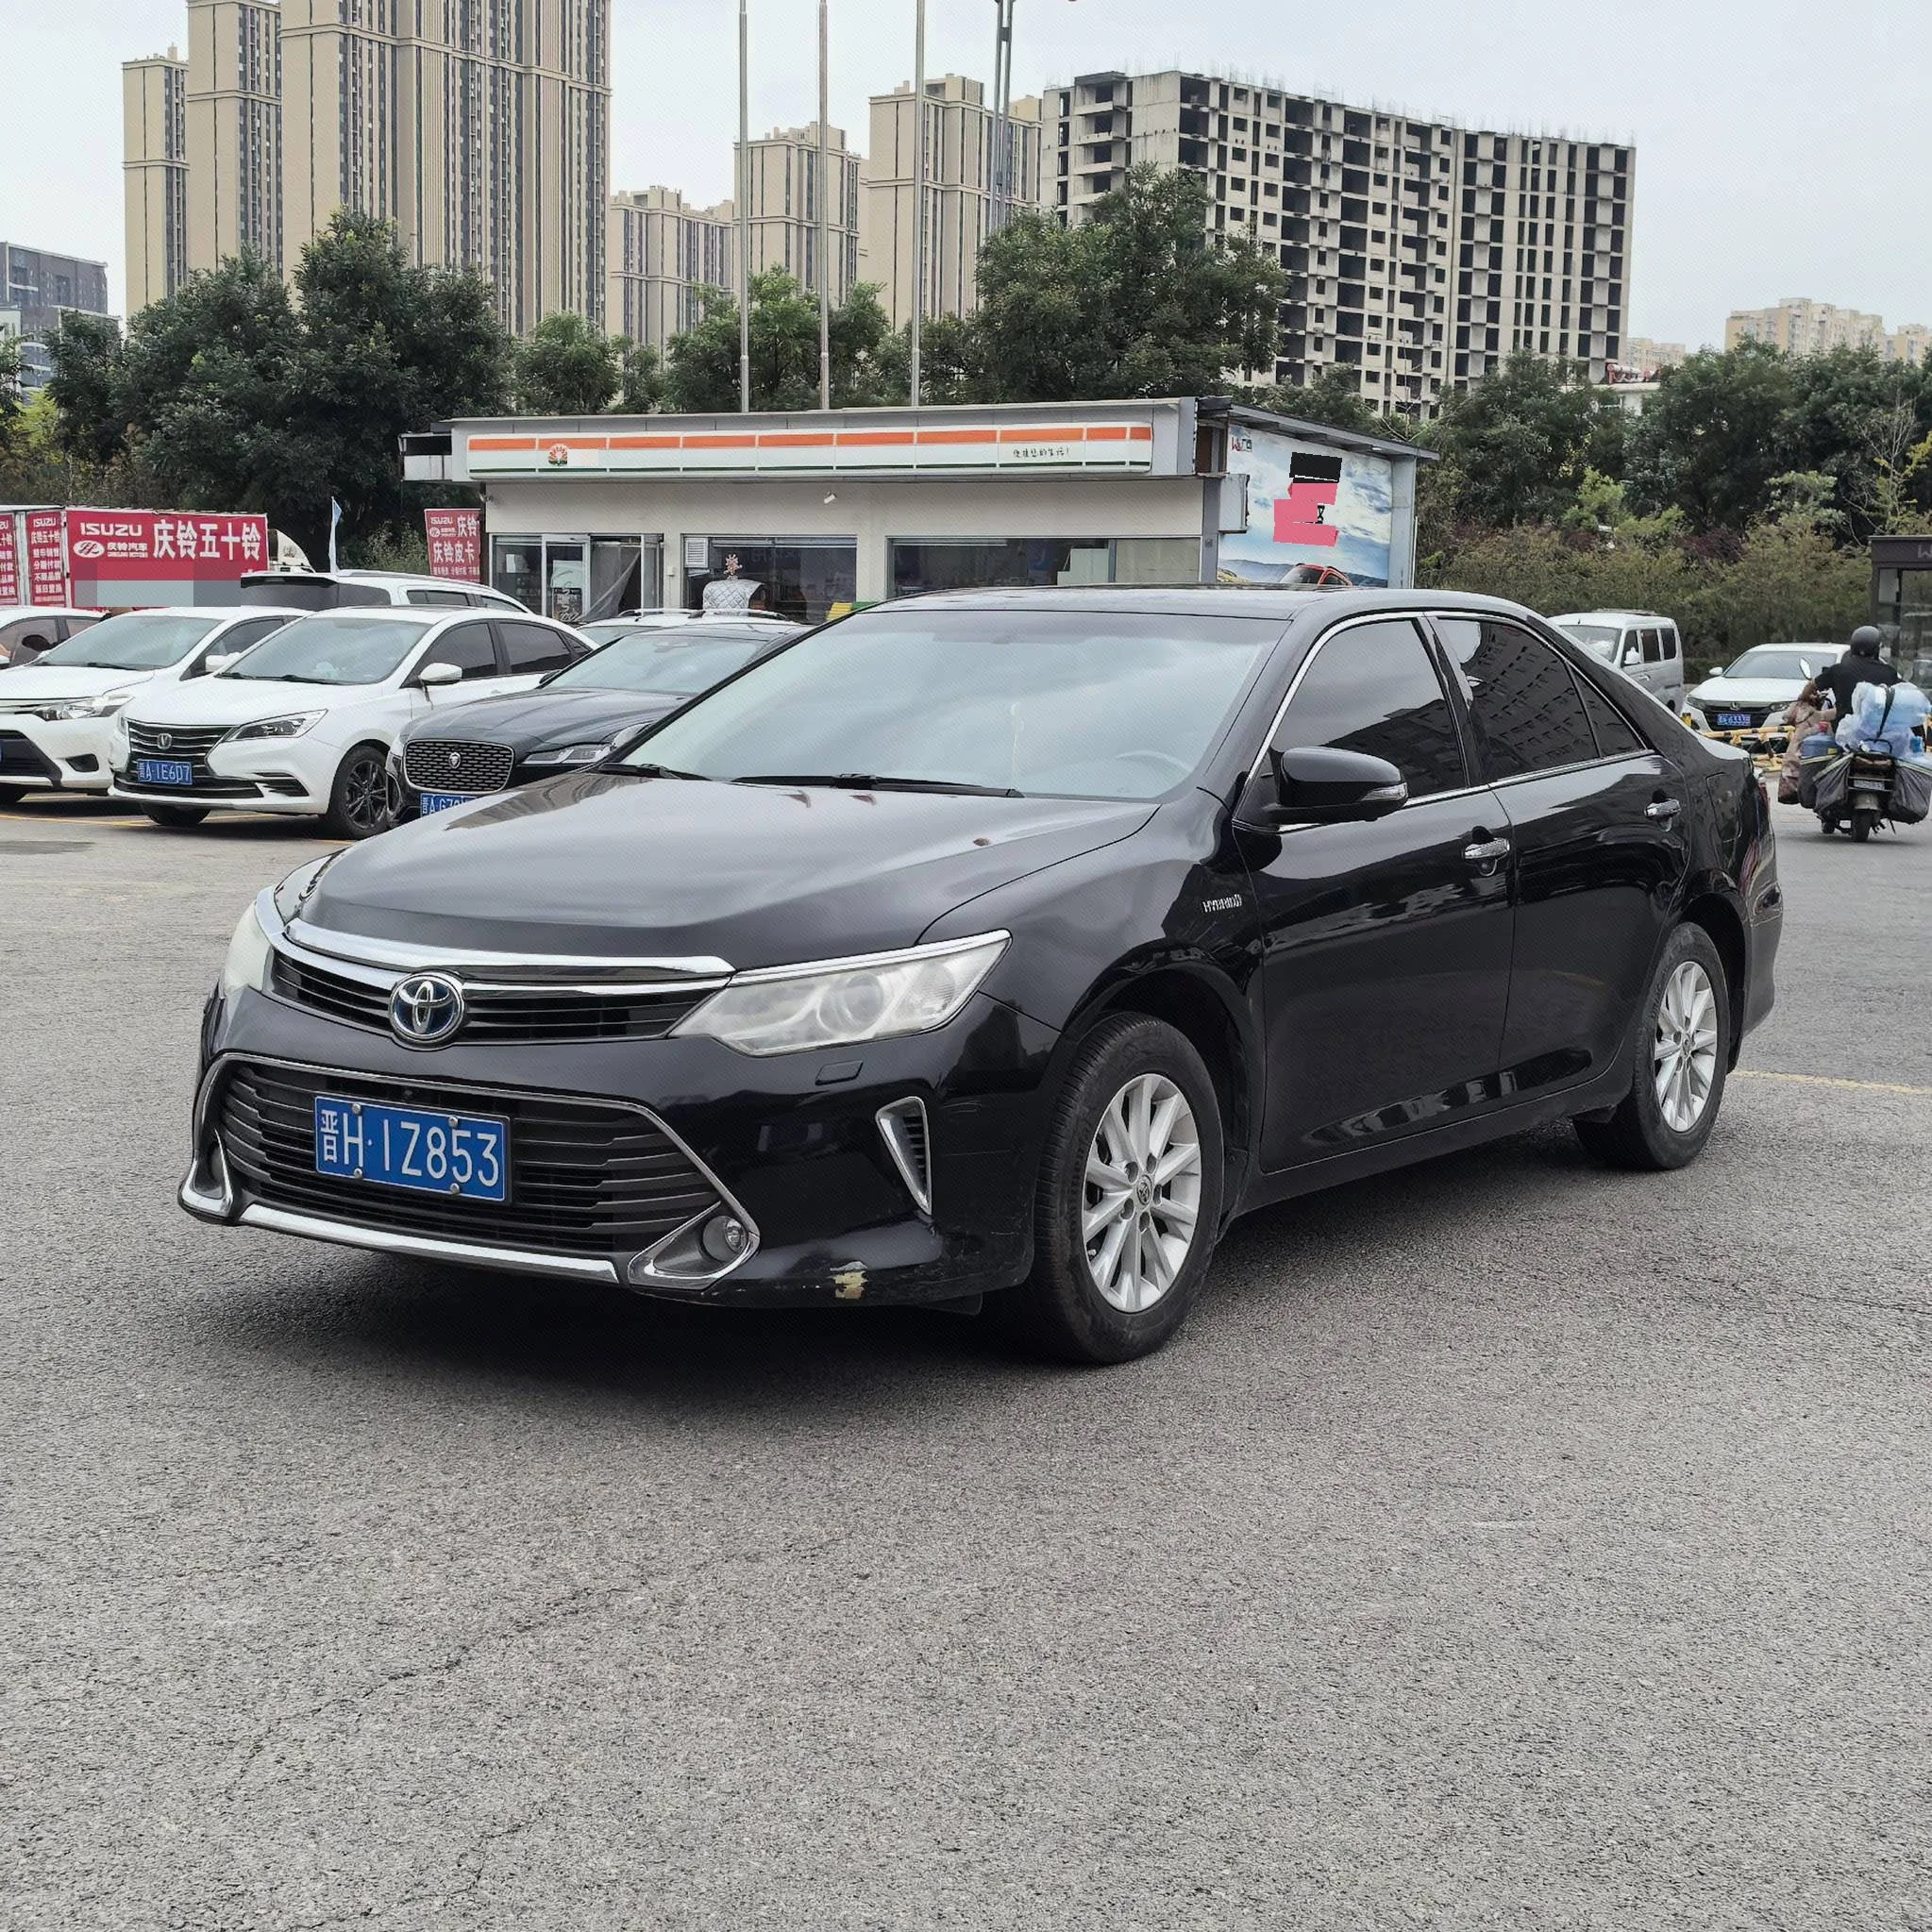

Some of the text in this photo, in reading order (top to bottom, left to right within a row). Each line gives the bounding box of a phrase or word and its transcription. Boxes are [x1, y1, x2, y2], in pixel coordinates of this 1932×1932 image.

[80, 522, 143, 537] ISUZU
[153, 519, 261, 561] 庆铃五十铃
[433, 540, 475, 564] 庆铃皮卡
[320, 1109, 499, 1187] 晋H·1Z853
